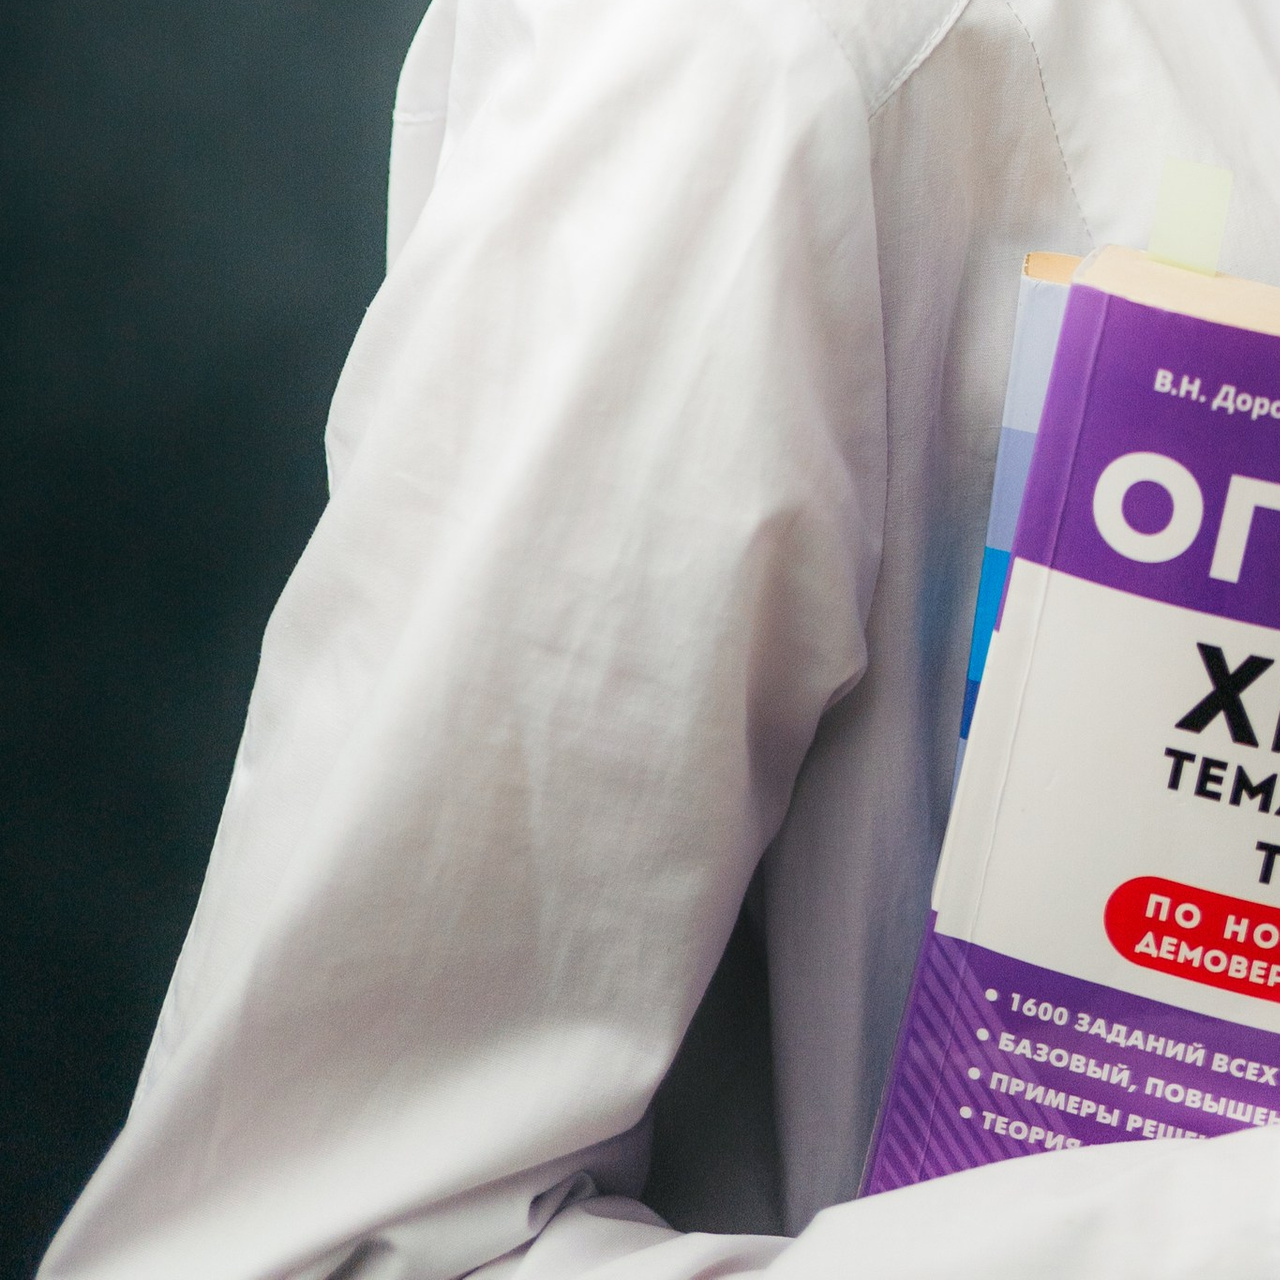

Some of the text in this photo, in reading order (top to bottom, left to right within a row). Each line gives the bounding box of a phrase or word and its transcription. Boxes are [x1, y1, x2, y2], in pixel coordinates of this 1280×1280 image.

[1153, 368, 1207, 403] В.Н.
[1145, 893, 1201, 929] ПО
[997, 1033, 1138, 1093] БАЗОВЫЙ,
[1009, 992, 1068, 1026] 1600
[1074, 1012, 1206, 1067] ЗАДАНИЙ
[1211, 1051, 1278, 1086] ВСЕХ
[989, 1072, 1120, 1127] ПРИМЕРЫ
